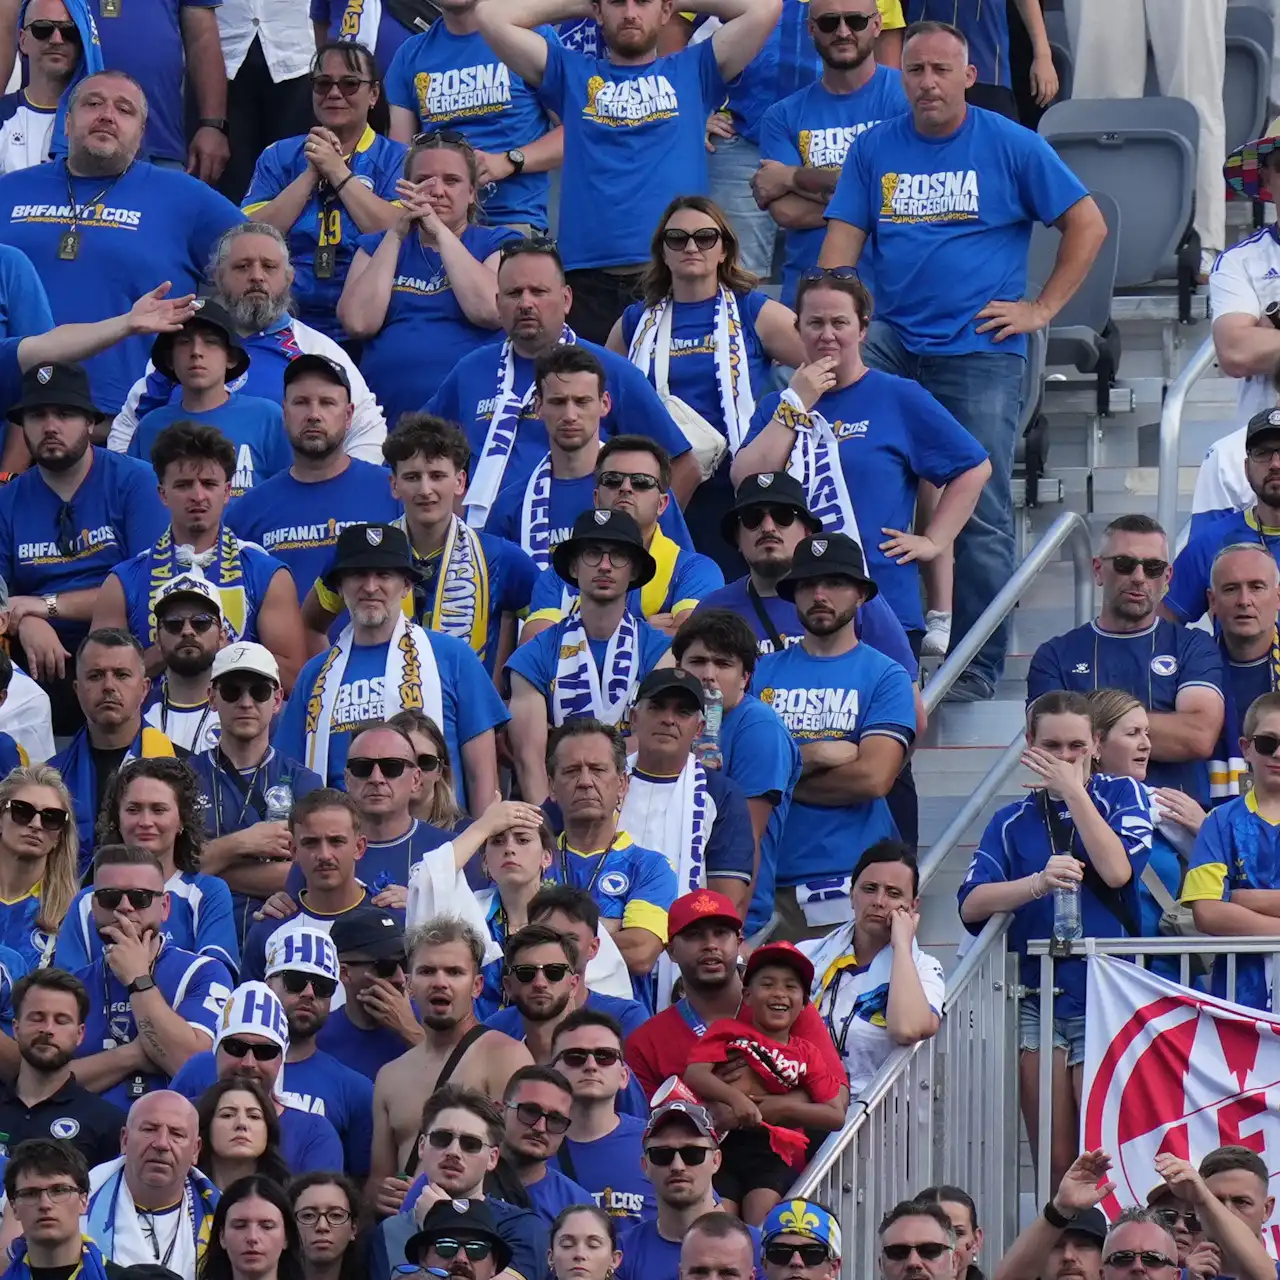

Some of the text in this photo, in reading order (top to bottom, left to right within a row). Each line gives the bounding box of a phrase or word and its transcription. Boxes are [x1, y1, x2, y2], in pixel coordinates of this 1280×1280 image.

[427, 62, 512, 96] BOSNA
[598, 76, 677, 108] BOSNA
[425, 90, 512, 114] HERCEGOVINA
[593, 96, 678, 121] HERCEGOVINA
[896, 169, 980, 201] BOSNA
[891, 194, 980, 214] HERCEGOVINA
[770, 688, 859, 717] BOSNA
